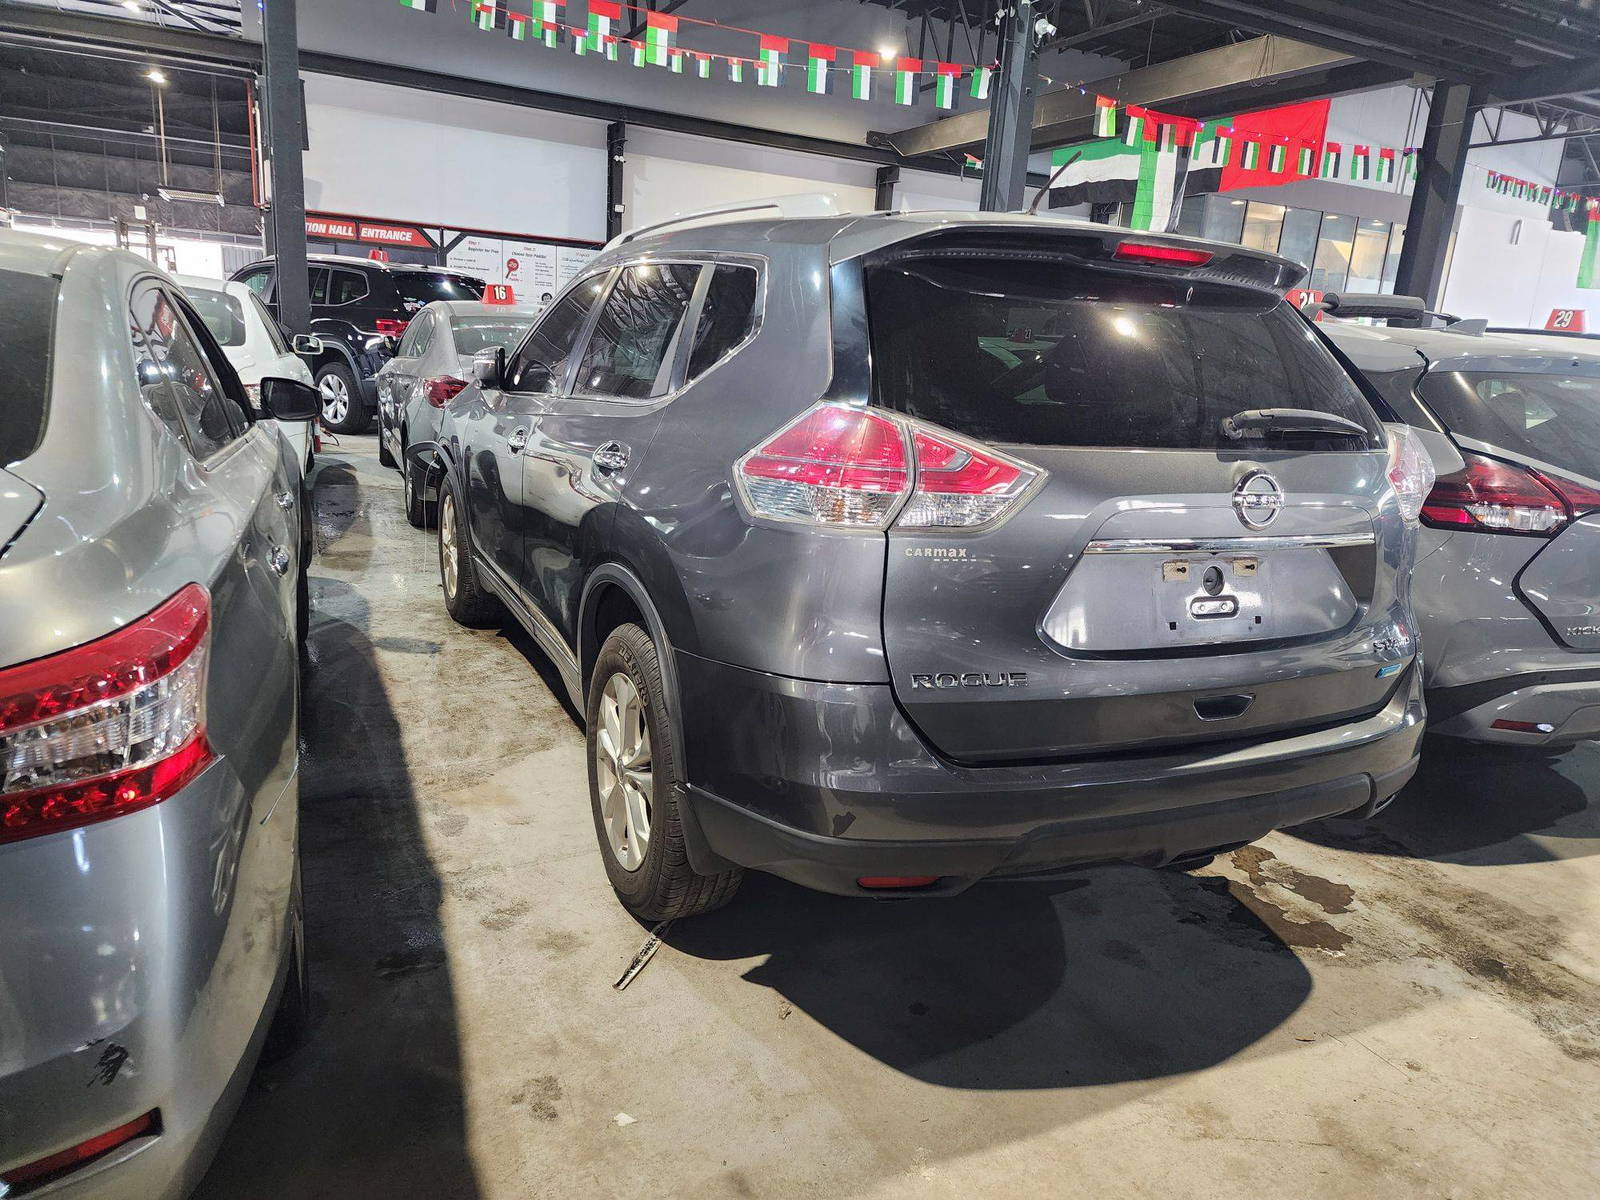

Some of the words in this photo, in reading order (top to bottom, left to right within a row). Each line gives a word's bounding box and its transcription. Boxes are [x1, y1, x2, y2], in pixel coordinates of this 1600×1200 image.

[328, 224, 354, 237] HALL
[361, 227, 413, 242] ENTRANCE
[494, 285, 507, 300] 16
[1553, 310, 1574, 328] 29
[911, 672, 1029, 689] ROGUE
